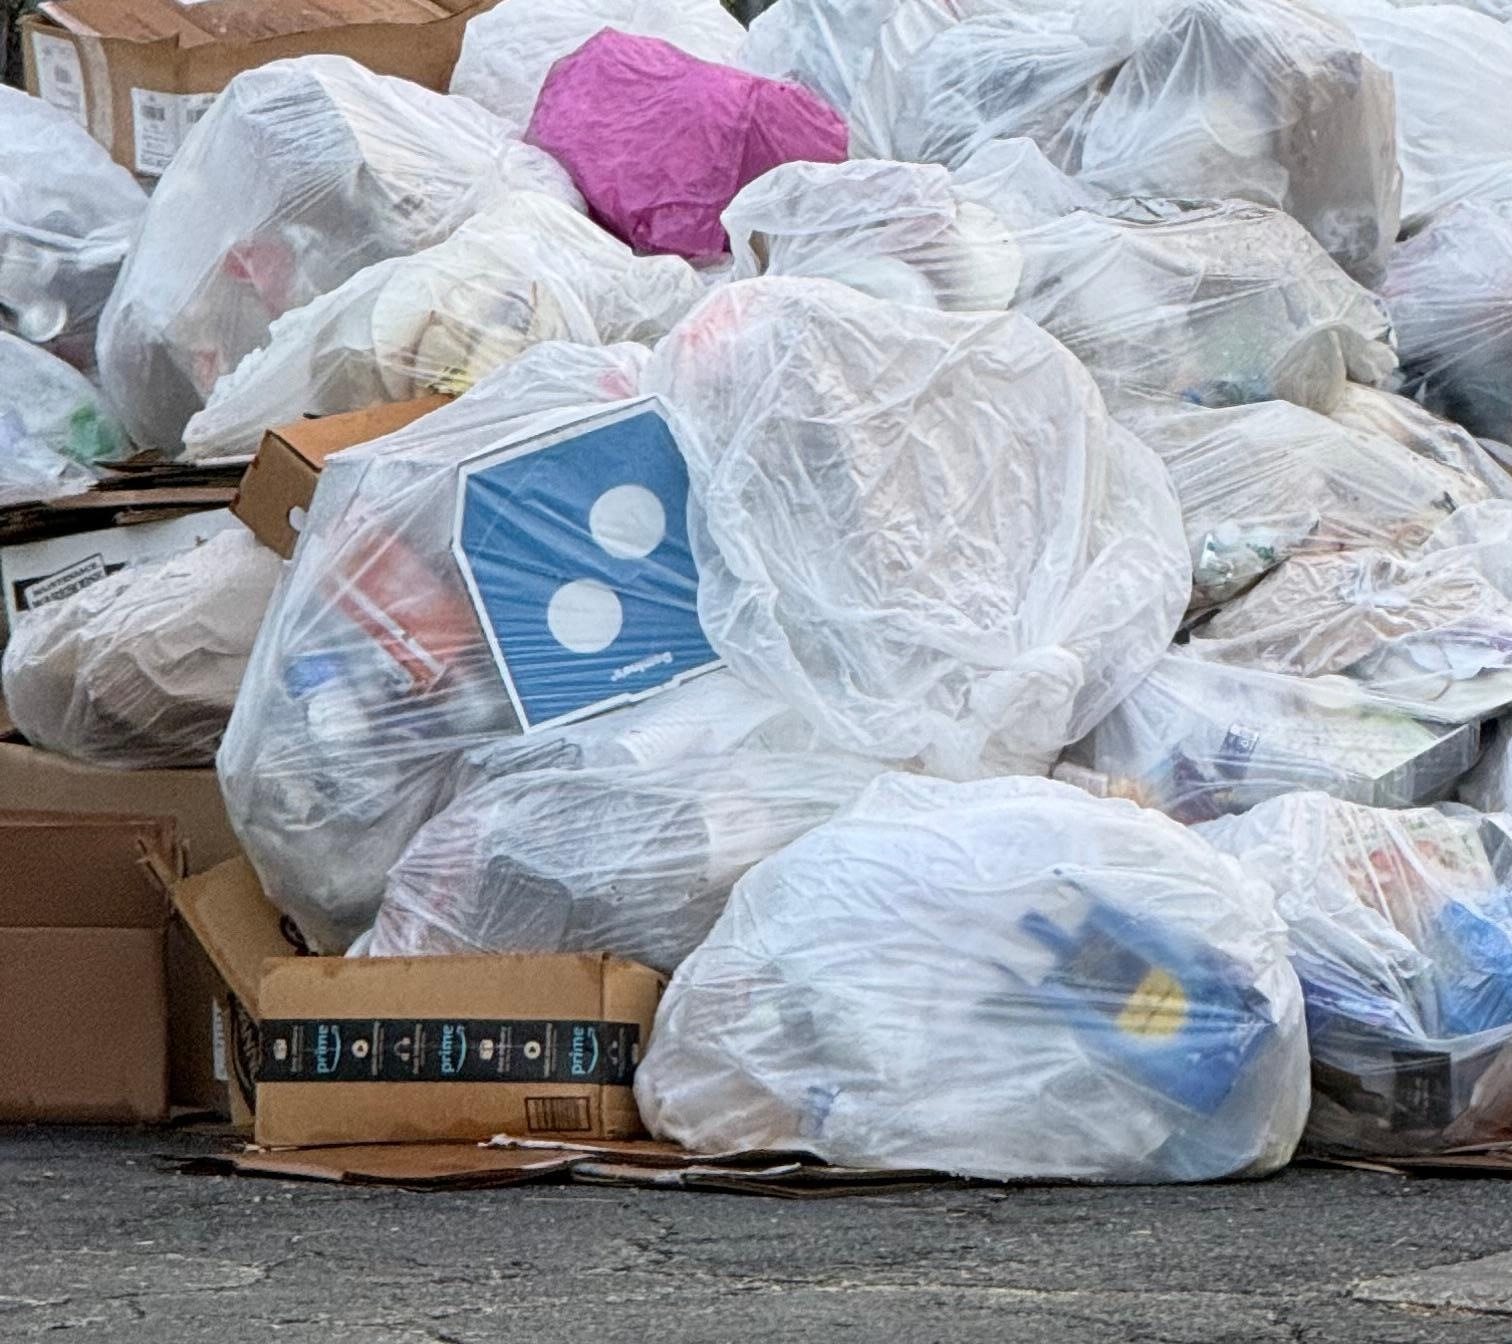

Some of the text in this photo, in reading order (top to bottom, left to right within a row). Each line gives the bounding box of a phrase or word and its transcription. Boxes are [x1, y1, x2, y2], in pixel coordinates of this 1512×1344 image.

[315, 1024, 329, 1073] prime
[438, 1024, 454, 1074] prime
[569, 1026, 586, 1076] prime
